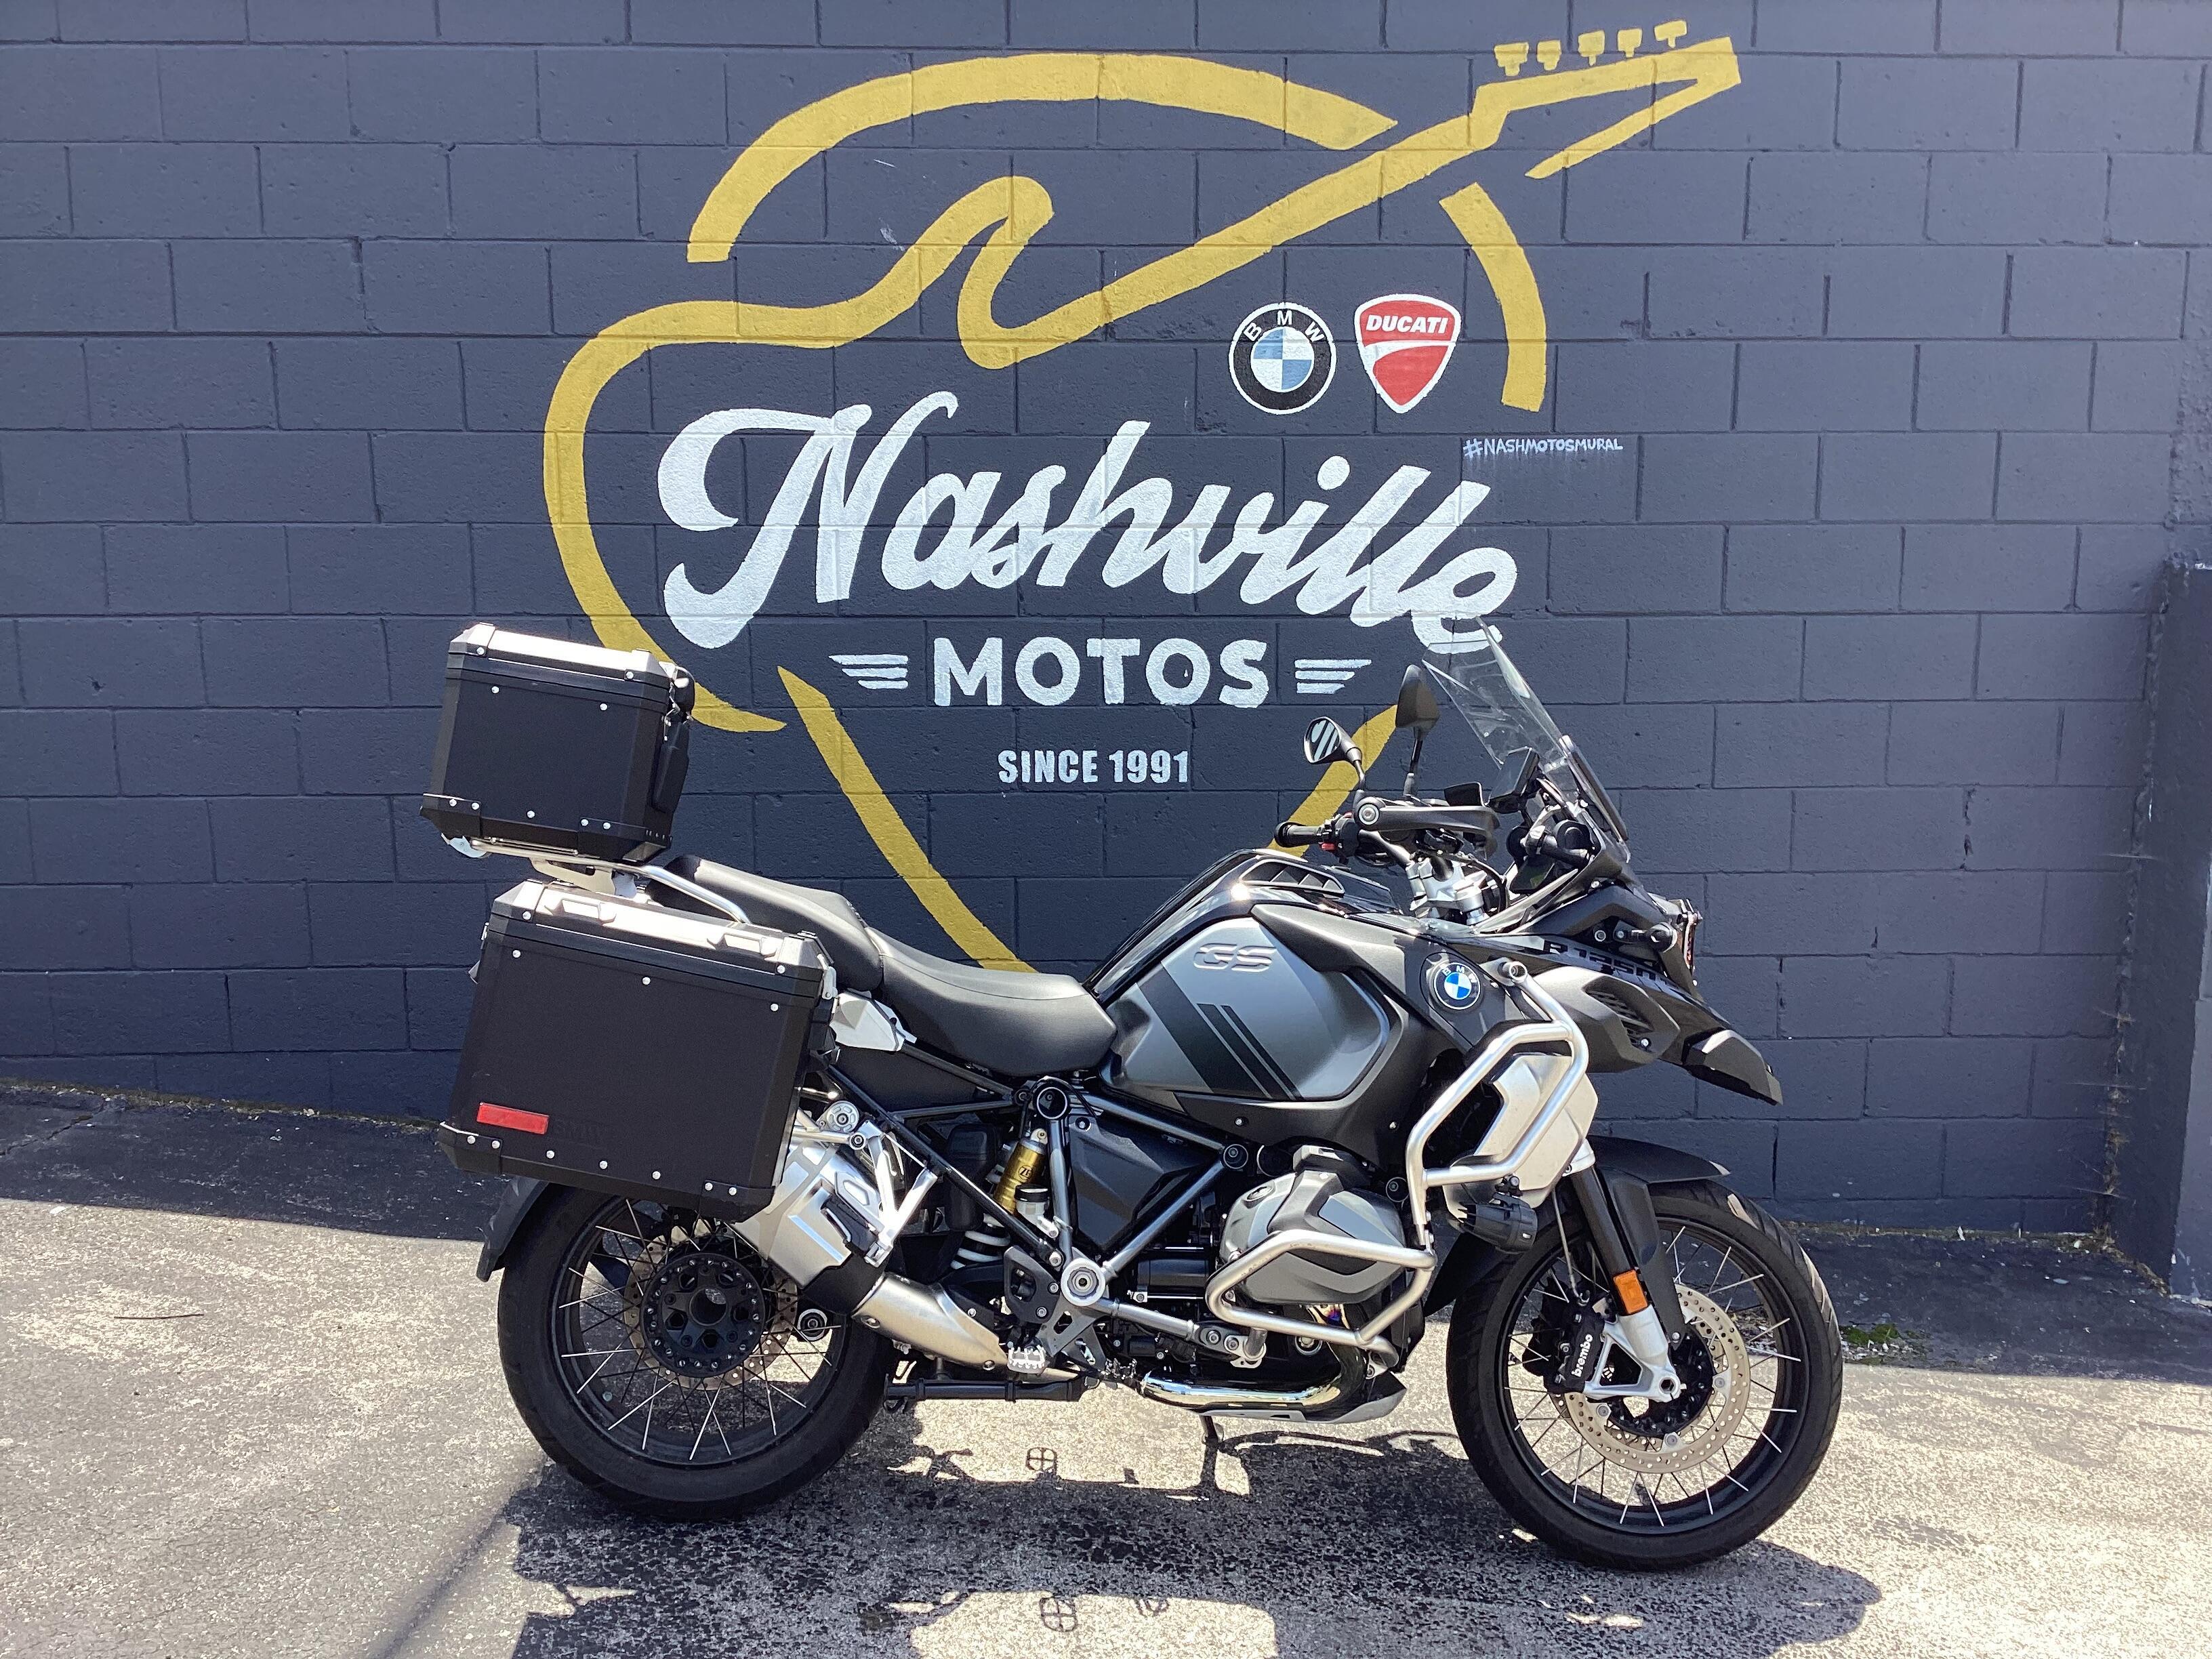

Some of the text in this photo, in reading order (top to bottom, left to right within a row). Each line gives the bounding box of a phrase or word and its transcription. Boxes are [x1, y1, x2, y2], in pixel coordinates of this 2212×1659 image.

[1243, 310, 1326, 344] BMW
[1366, 314, 1448, 334] DUCATI
[1463, 438, 1624, 457] #NASHMOTOSMURAL
[658, 391, 1518, 653] Nashville
[934, 636, 1269, 707] MOTOS
[998, 749, 1189, 783] SINCE 1991
[1193, 943, 1277, 972] GS
[1441, 965, 1478, 983] BMW
[1571, 1334, 1593, 1377] brembo
